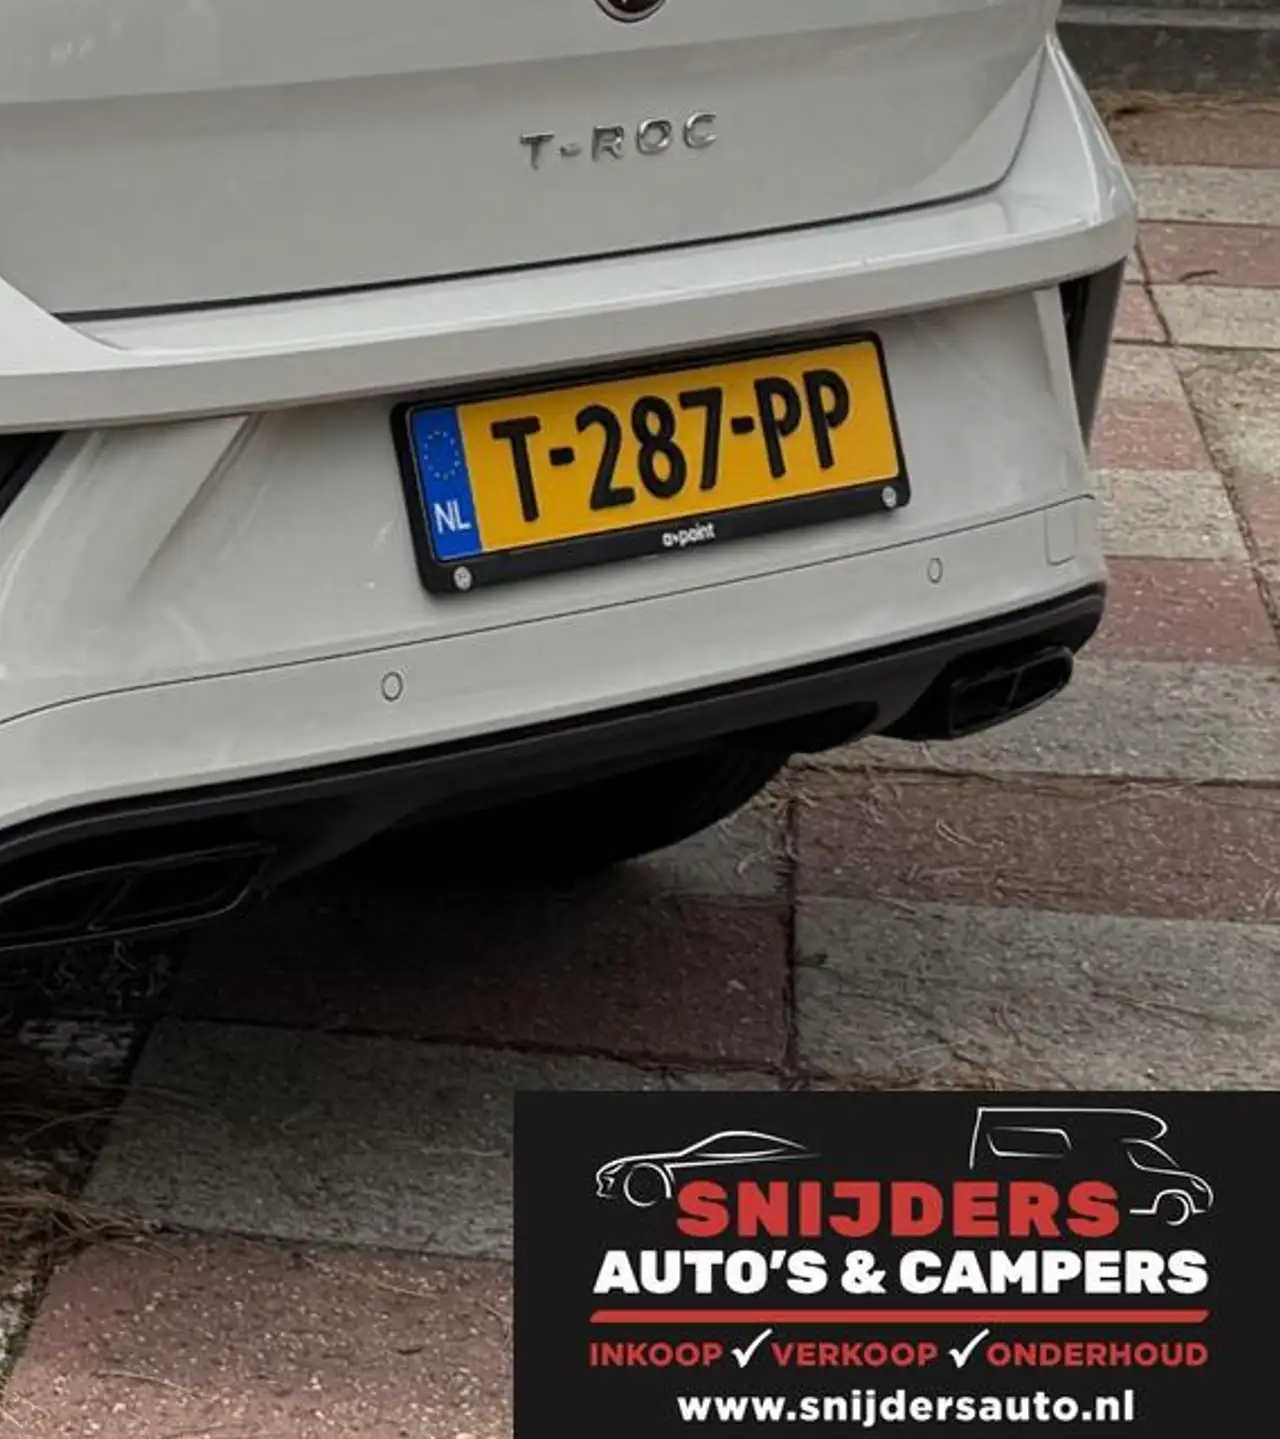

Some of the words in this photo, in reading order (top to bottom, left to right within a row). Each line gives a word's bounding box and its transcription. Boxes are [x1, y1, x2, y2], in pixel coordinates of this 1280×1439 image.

[520, 112, 717, 170] T-ROC
[490, 368, 851, 523] T-287-PP
[433, 500, 471, 533] NL
